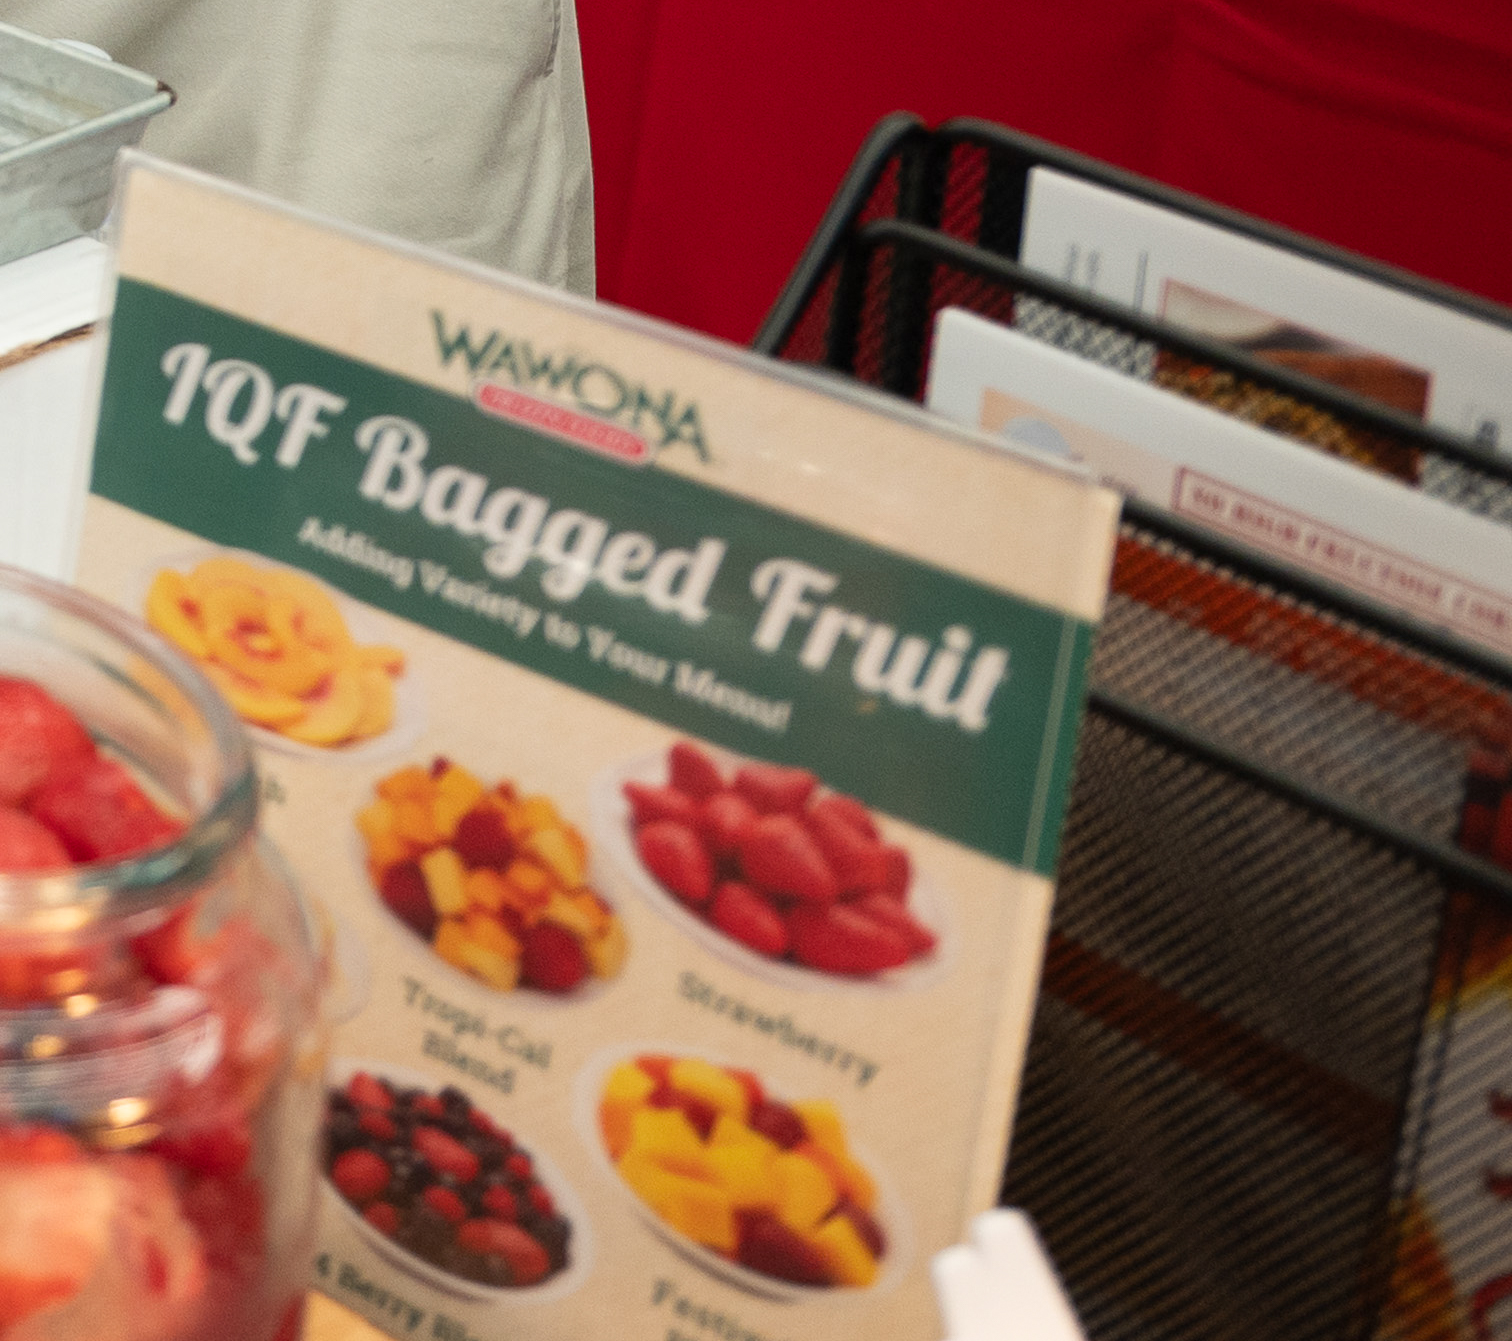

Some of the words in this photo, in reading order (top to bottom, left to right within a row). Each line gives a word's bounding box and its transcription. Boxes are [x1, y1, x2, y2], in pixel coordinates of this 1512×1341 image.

[429, 310, 712, 465] WAWONA
[161, 342, 348, 468] IQF
[354, 413, 727, 624] Bagged
[750, 557, 1011, 734] Fruit
[298, 516, 417, 589] Adding
[417, 559, 543, 638] Variety
[545, 613, 581, 650] to
[586, 623, 668, 685] Your
[671, 660, 792, 734] Menu!
[399, 975, 554, 1072] Tropi-Cal
[420, 1028, 518, 1096] Blend
[676, 970, 880, 1089] Strawberry
[336, 1261, 426, 1333] Berry
